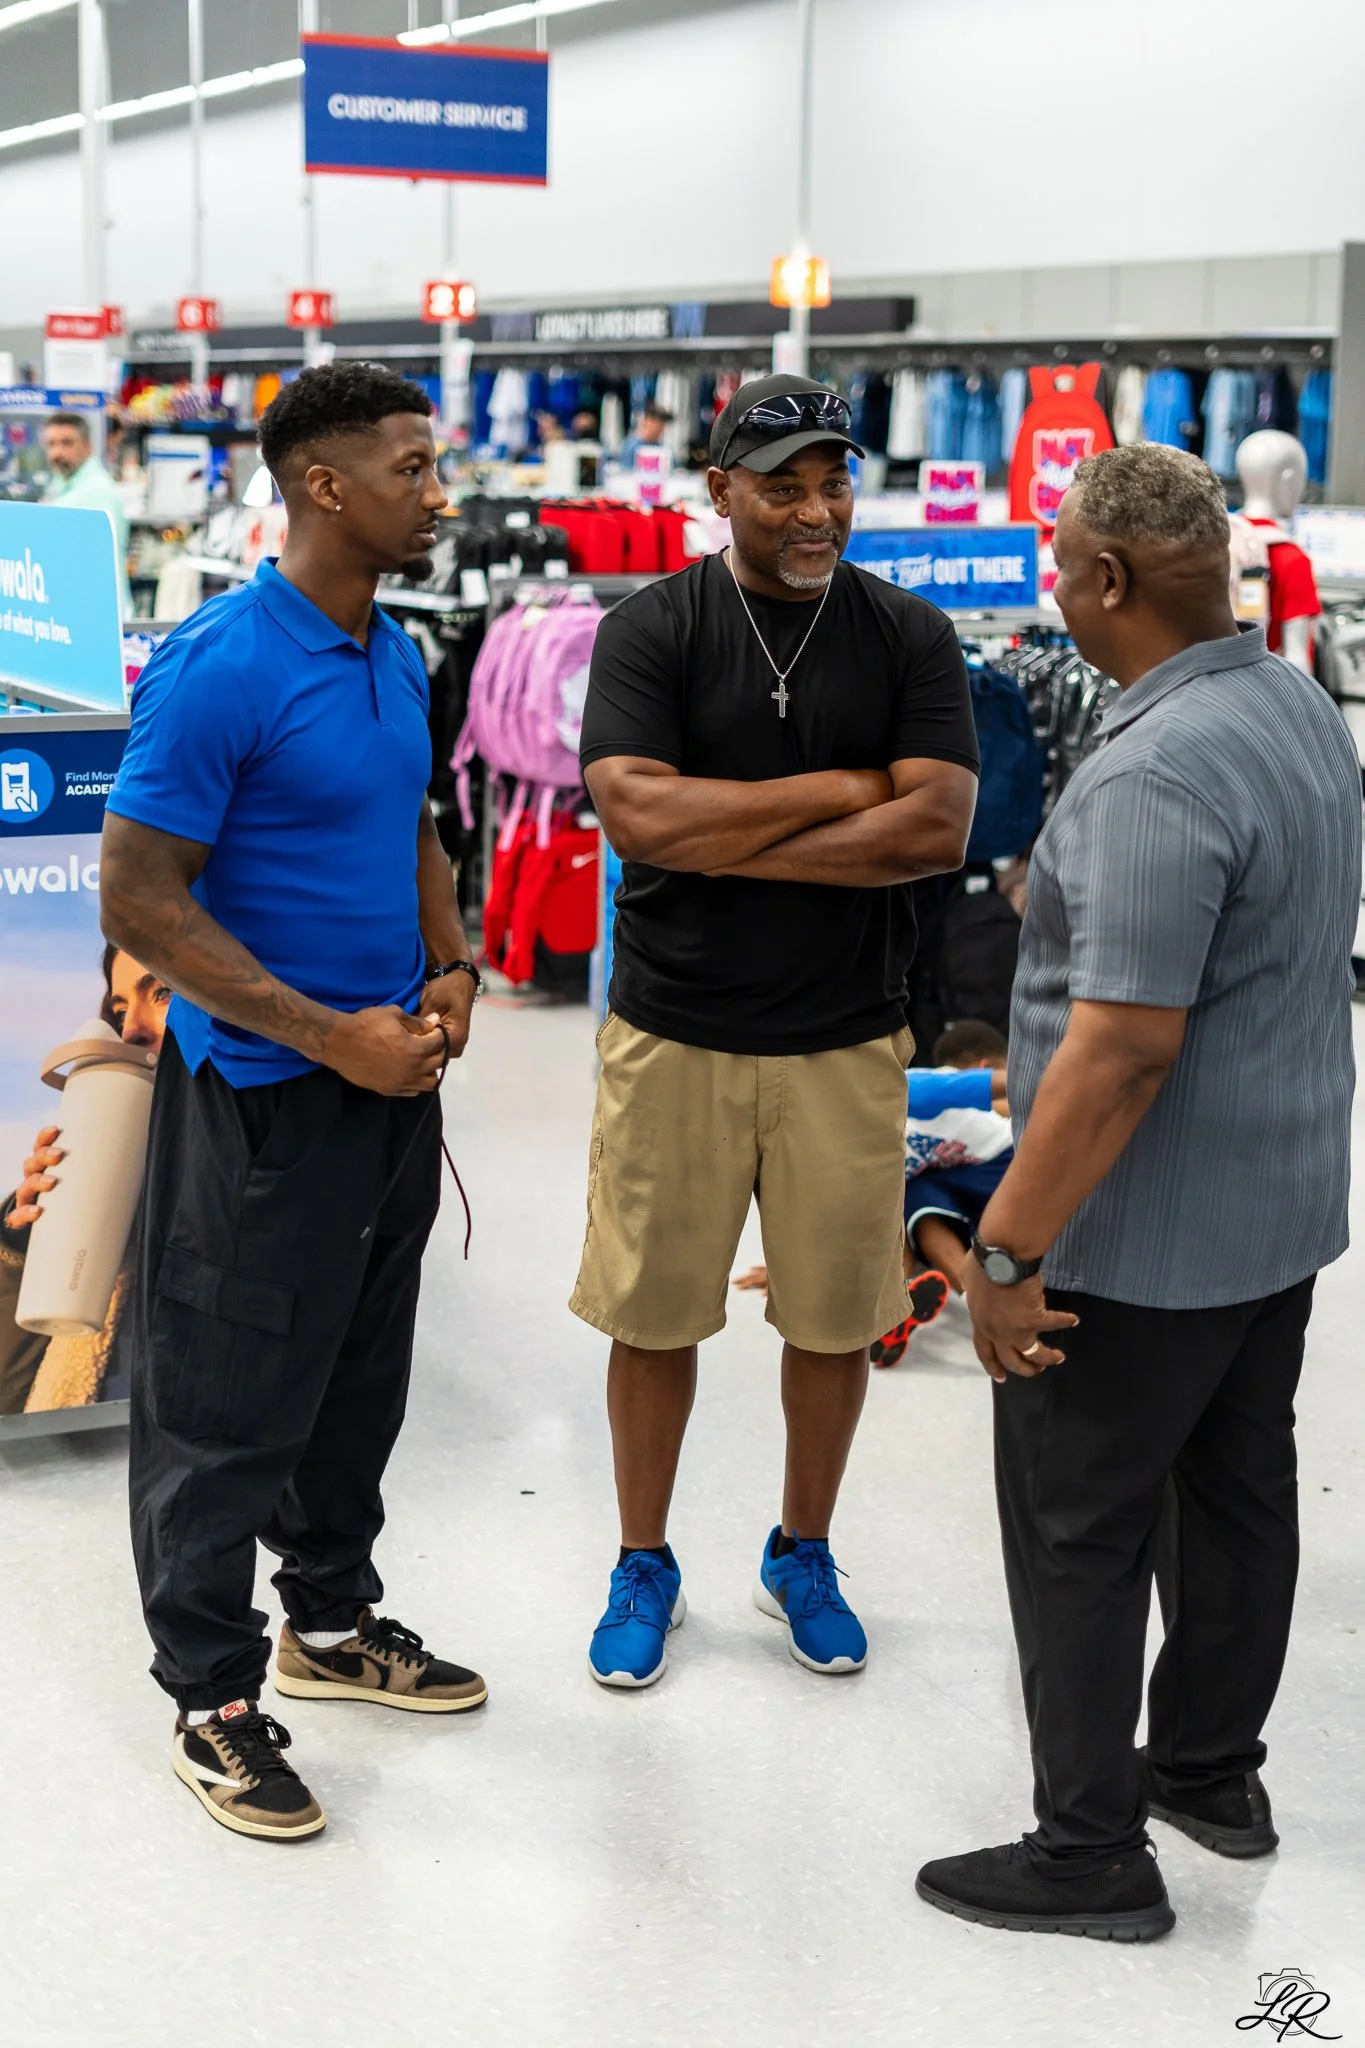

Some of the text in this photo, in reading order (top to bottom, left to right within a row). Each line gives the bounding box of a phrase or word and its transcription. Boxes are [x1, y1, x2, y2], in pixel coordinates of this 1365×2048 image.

[328, 93, 528, 132] CUSTOMER SERVICE
[934, 557, 968, 585] OUT
[972, 556, 1026, 583] THERE
[13, 611, 33, 636] what
[33, 620, 50, 643] you
[51, 616, 72, 645] love.
[65, 772, 90, 782] Find
[0, 855, 99, 895] wala
[69, 1249, 87, 1291] owala
